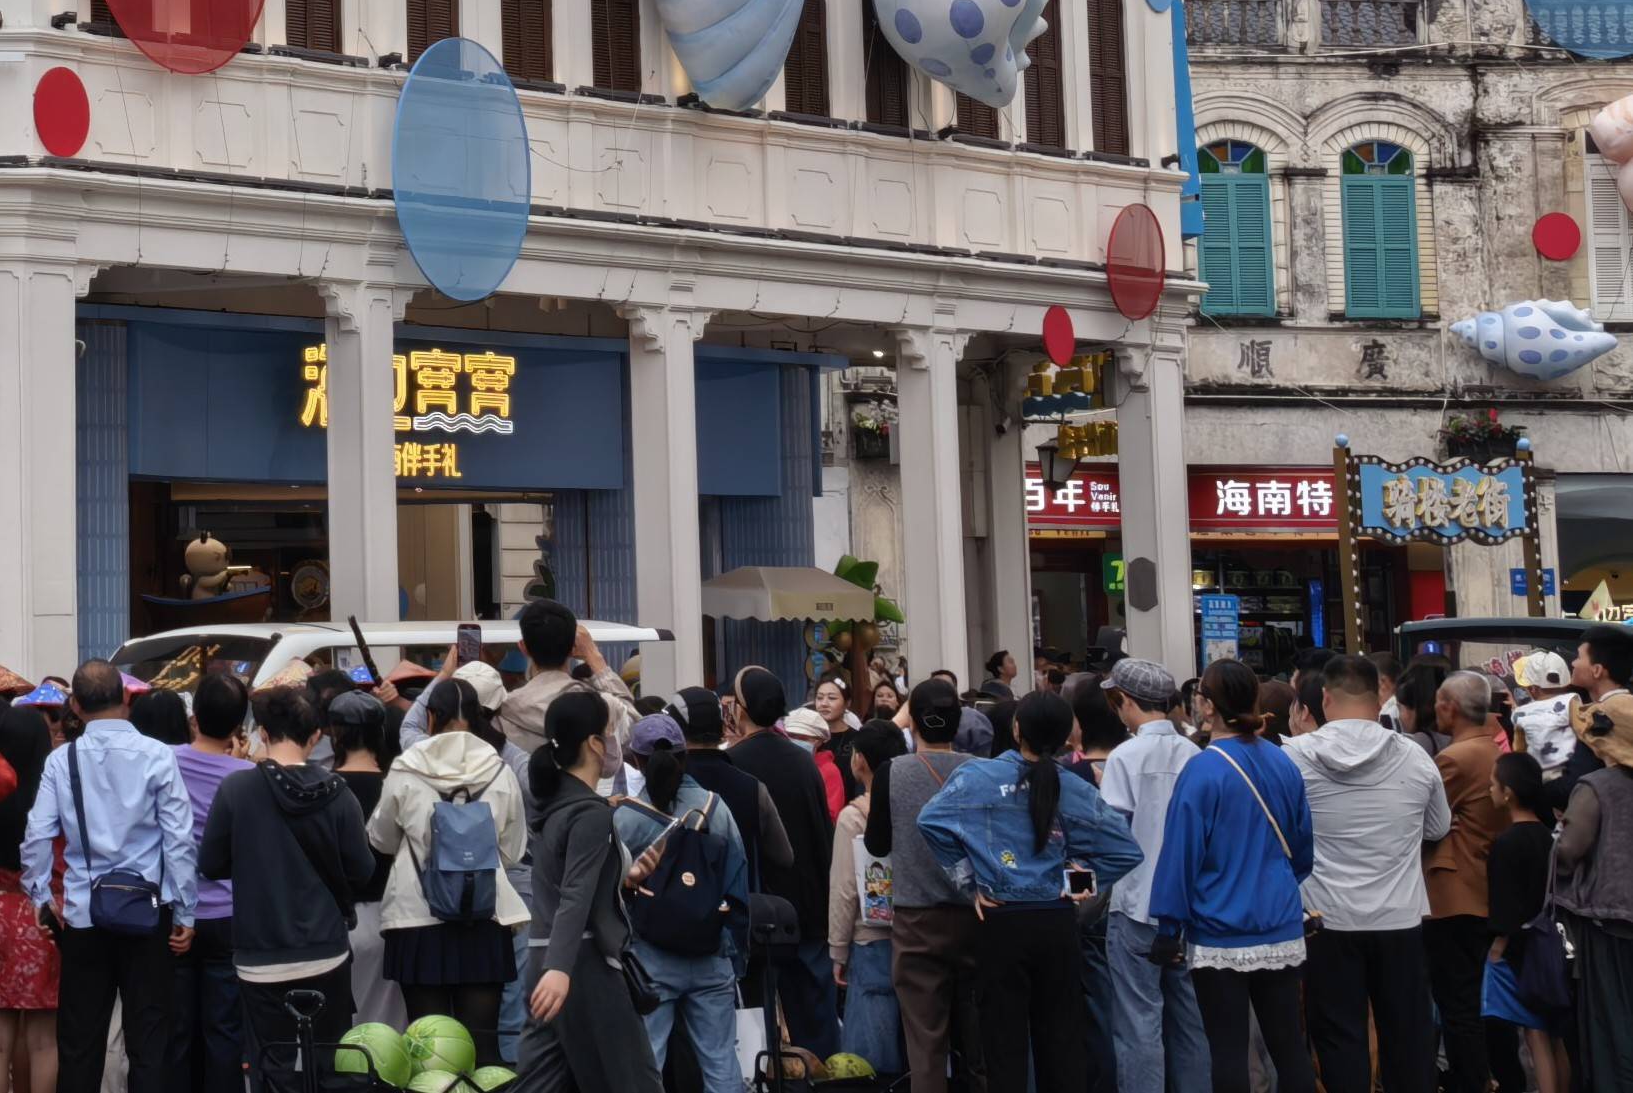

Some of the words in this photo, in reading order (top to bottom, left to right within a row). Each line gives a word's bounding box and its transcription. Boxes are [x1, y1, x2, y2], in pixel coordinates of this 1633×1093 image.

[1216, 480, 1333, 516] 海南特
[1382, 474, 1511, 529] 骑楼老街
